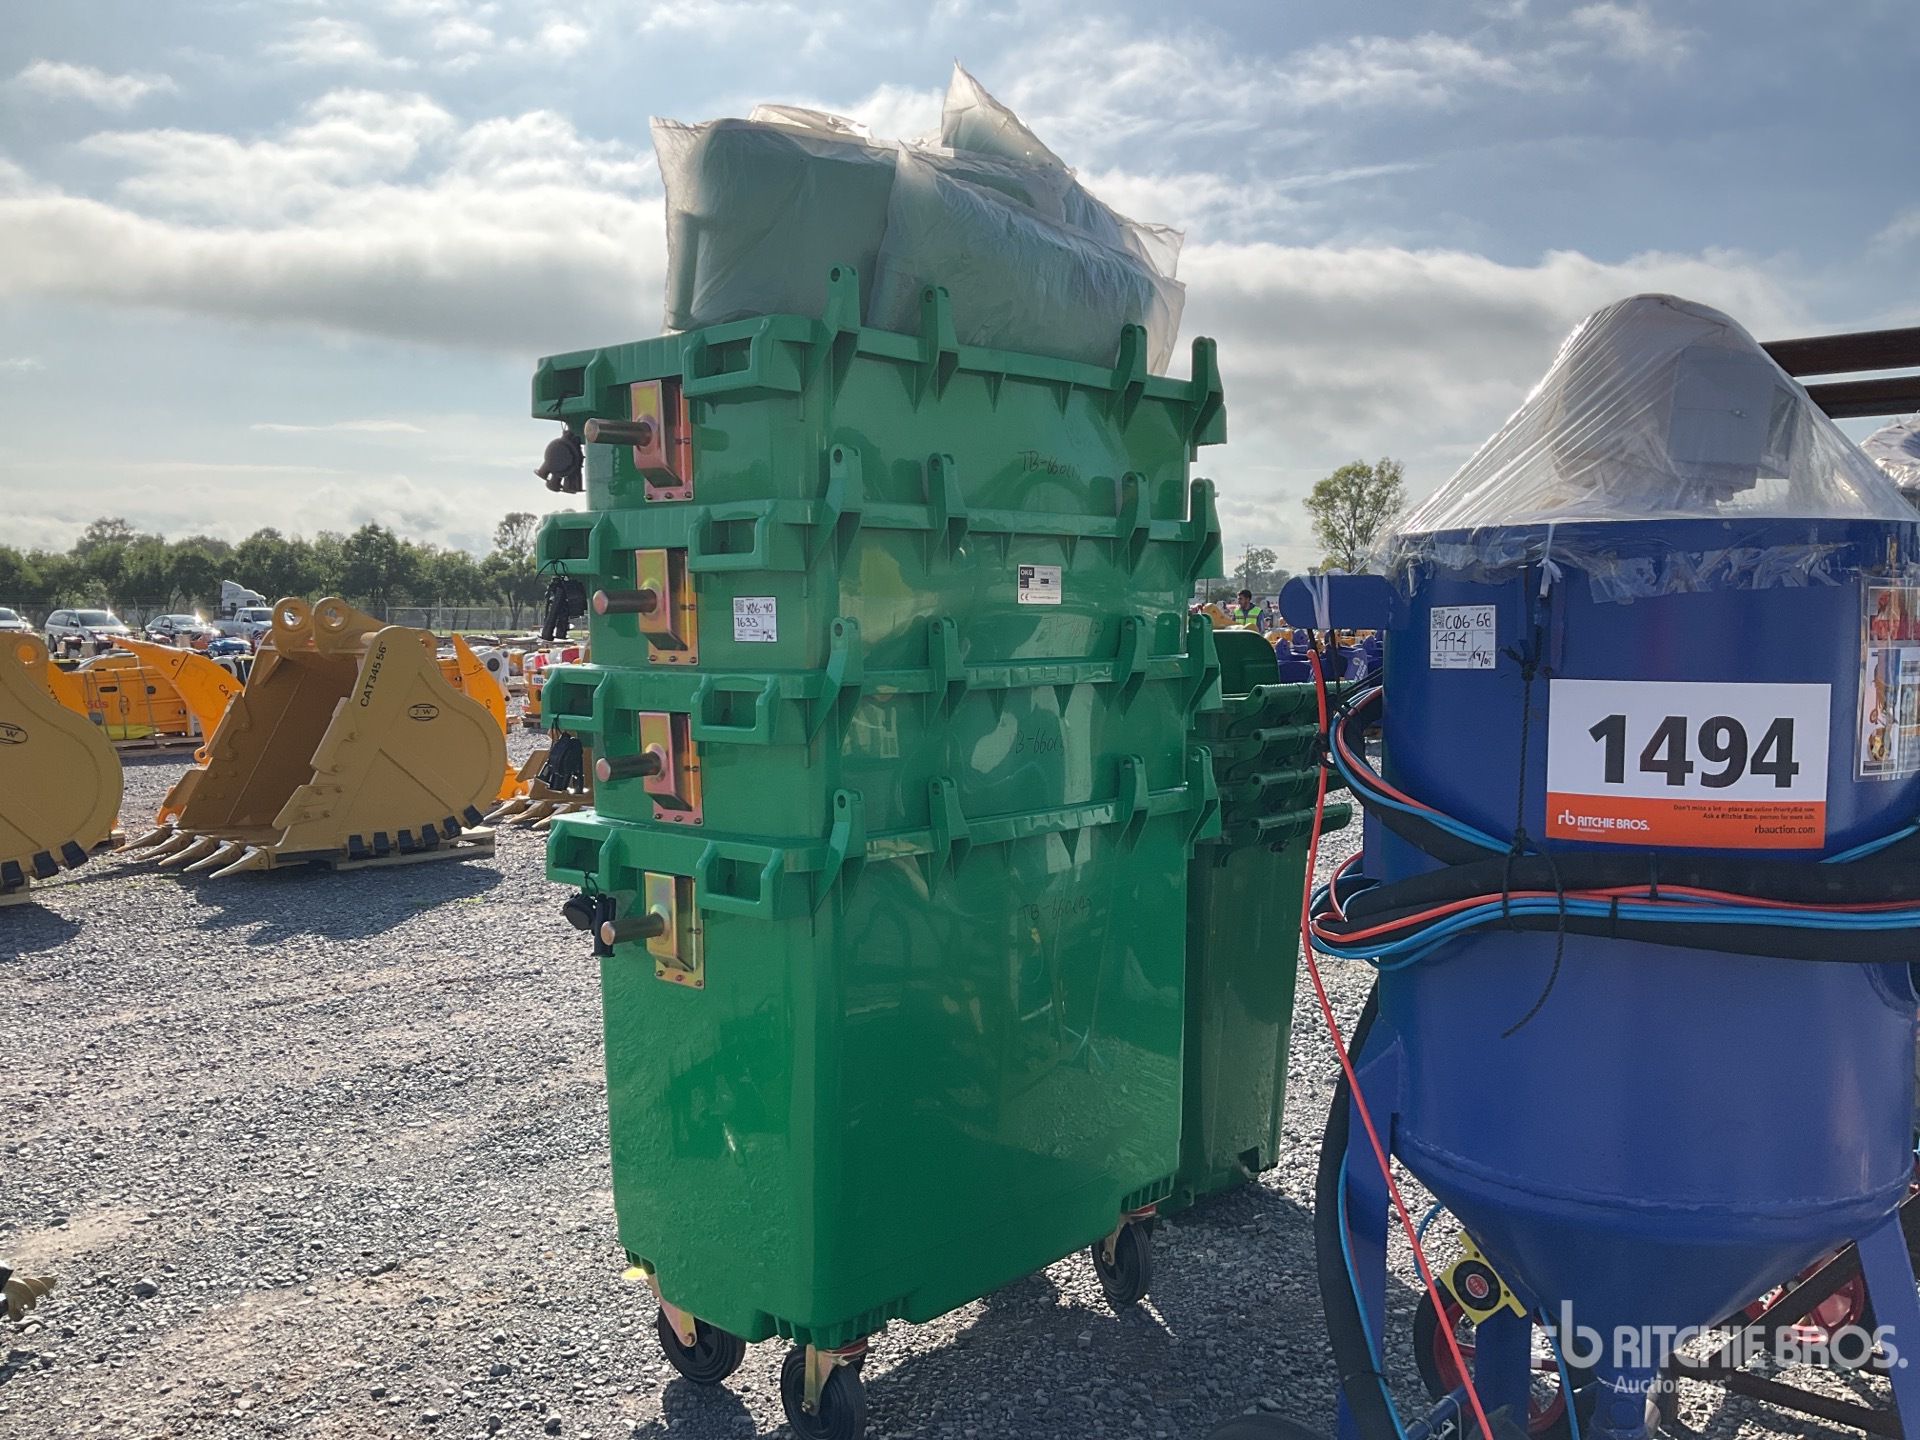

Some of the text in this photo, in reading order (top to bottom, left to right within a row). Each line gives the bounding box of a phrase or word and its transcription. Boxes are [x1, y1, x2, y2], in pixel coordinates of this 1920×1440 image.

[735, 617, 758, 628] 1633
[1432, 630, 1467, 651] 1494
[360, 661, 382, 708] CAT345
[1588, 714, 1799, 788] 1494
[1577, 815, 1616, 830] RITCHIE
[1616, 818, 1650, 831] BROS.
[1754, 824, 1816, 834] rbauction.com
